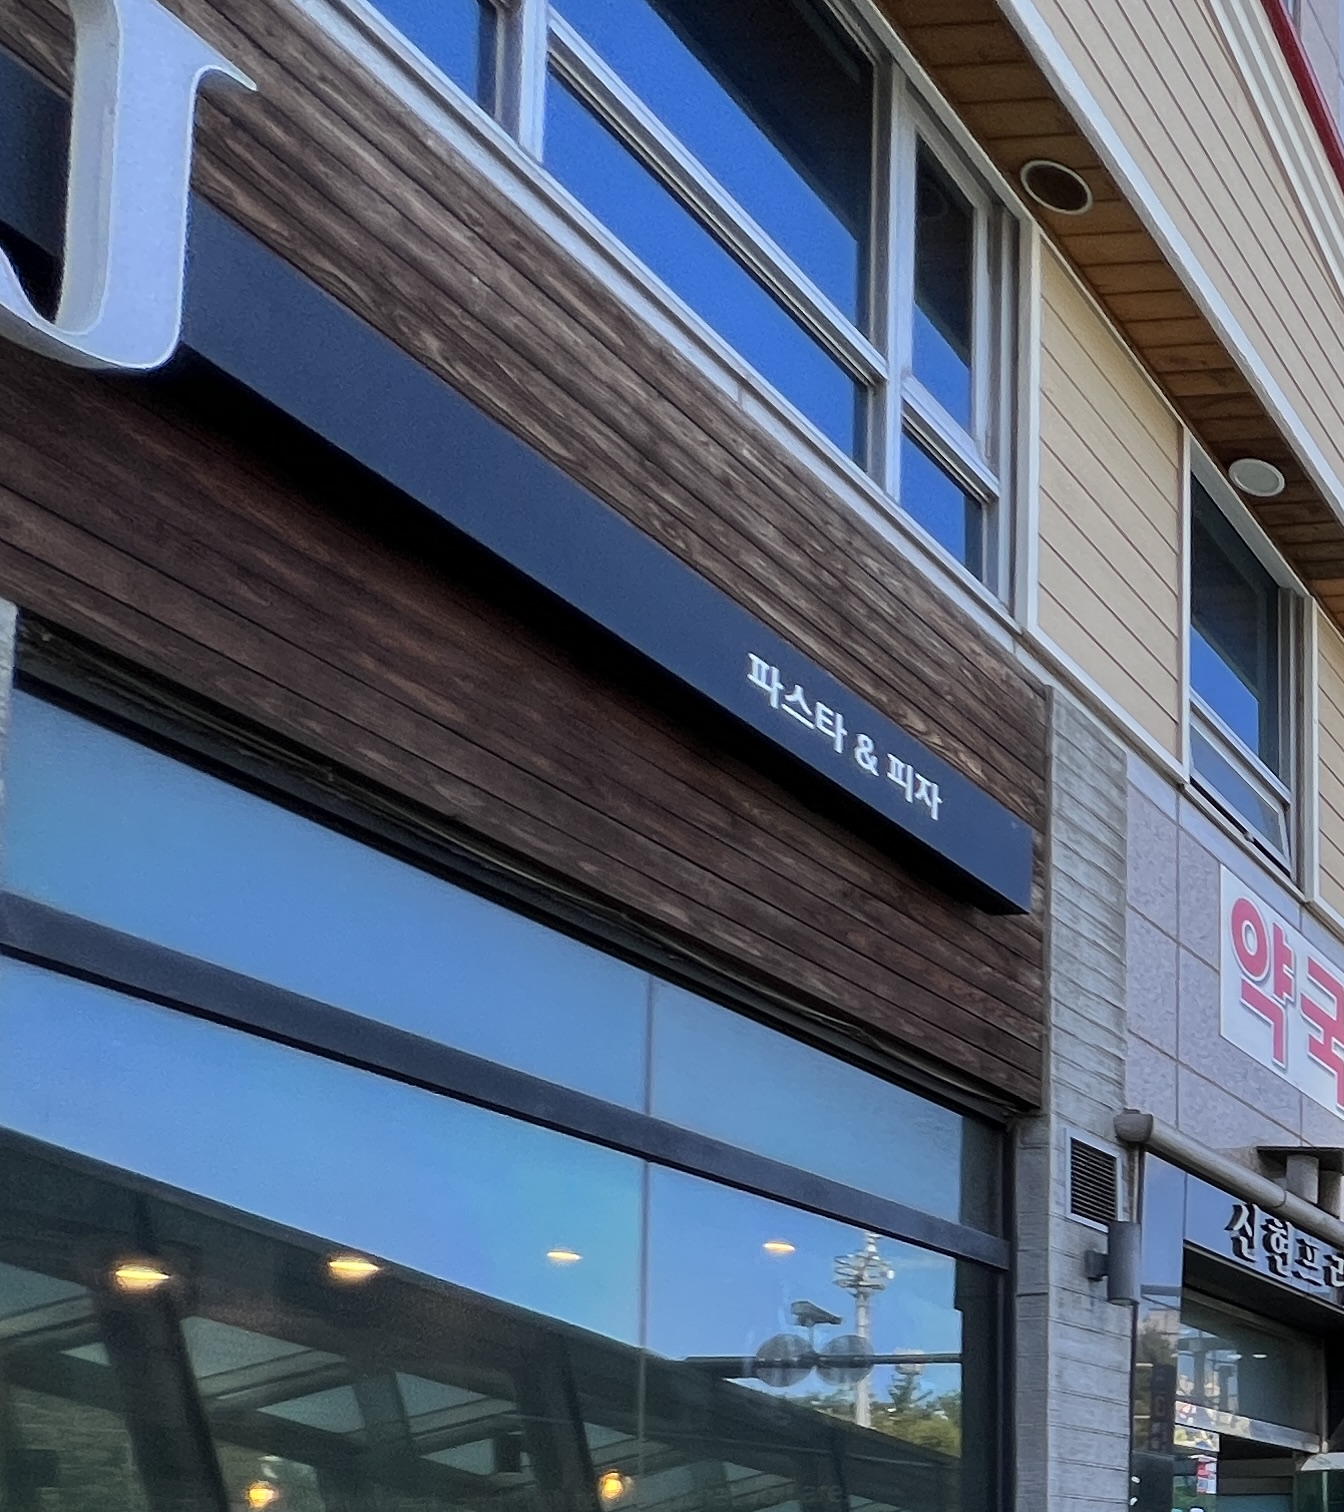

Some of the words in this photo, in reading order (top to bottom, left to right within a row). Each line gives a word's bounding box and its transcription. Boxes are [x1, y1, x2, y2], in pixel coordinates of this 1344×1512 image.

[747, 652, 848, 754] 파스타
[853, 732, 880, 777] &
[886, 752, 943, 821] 피자
